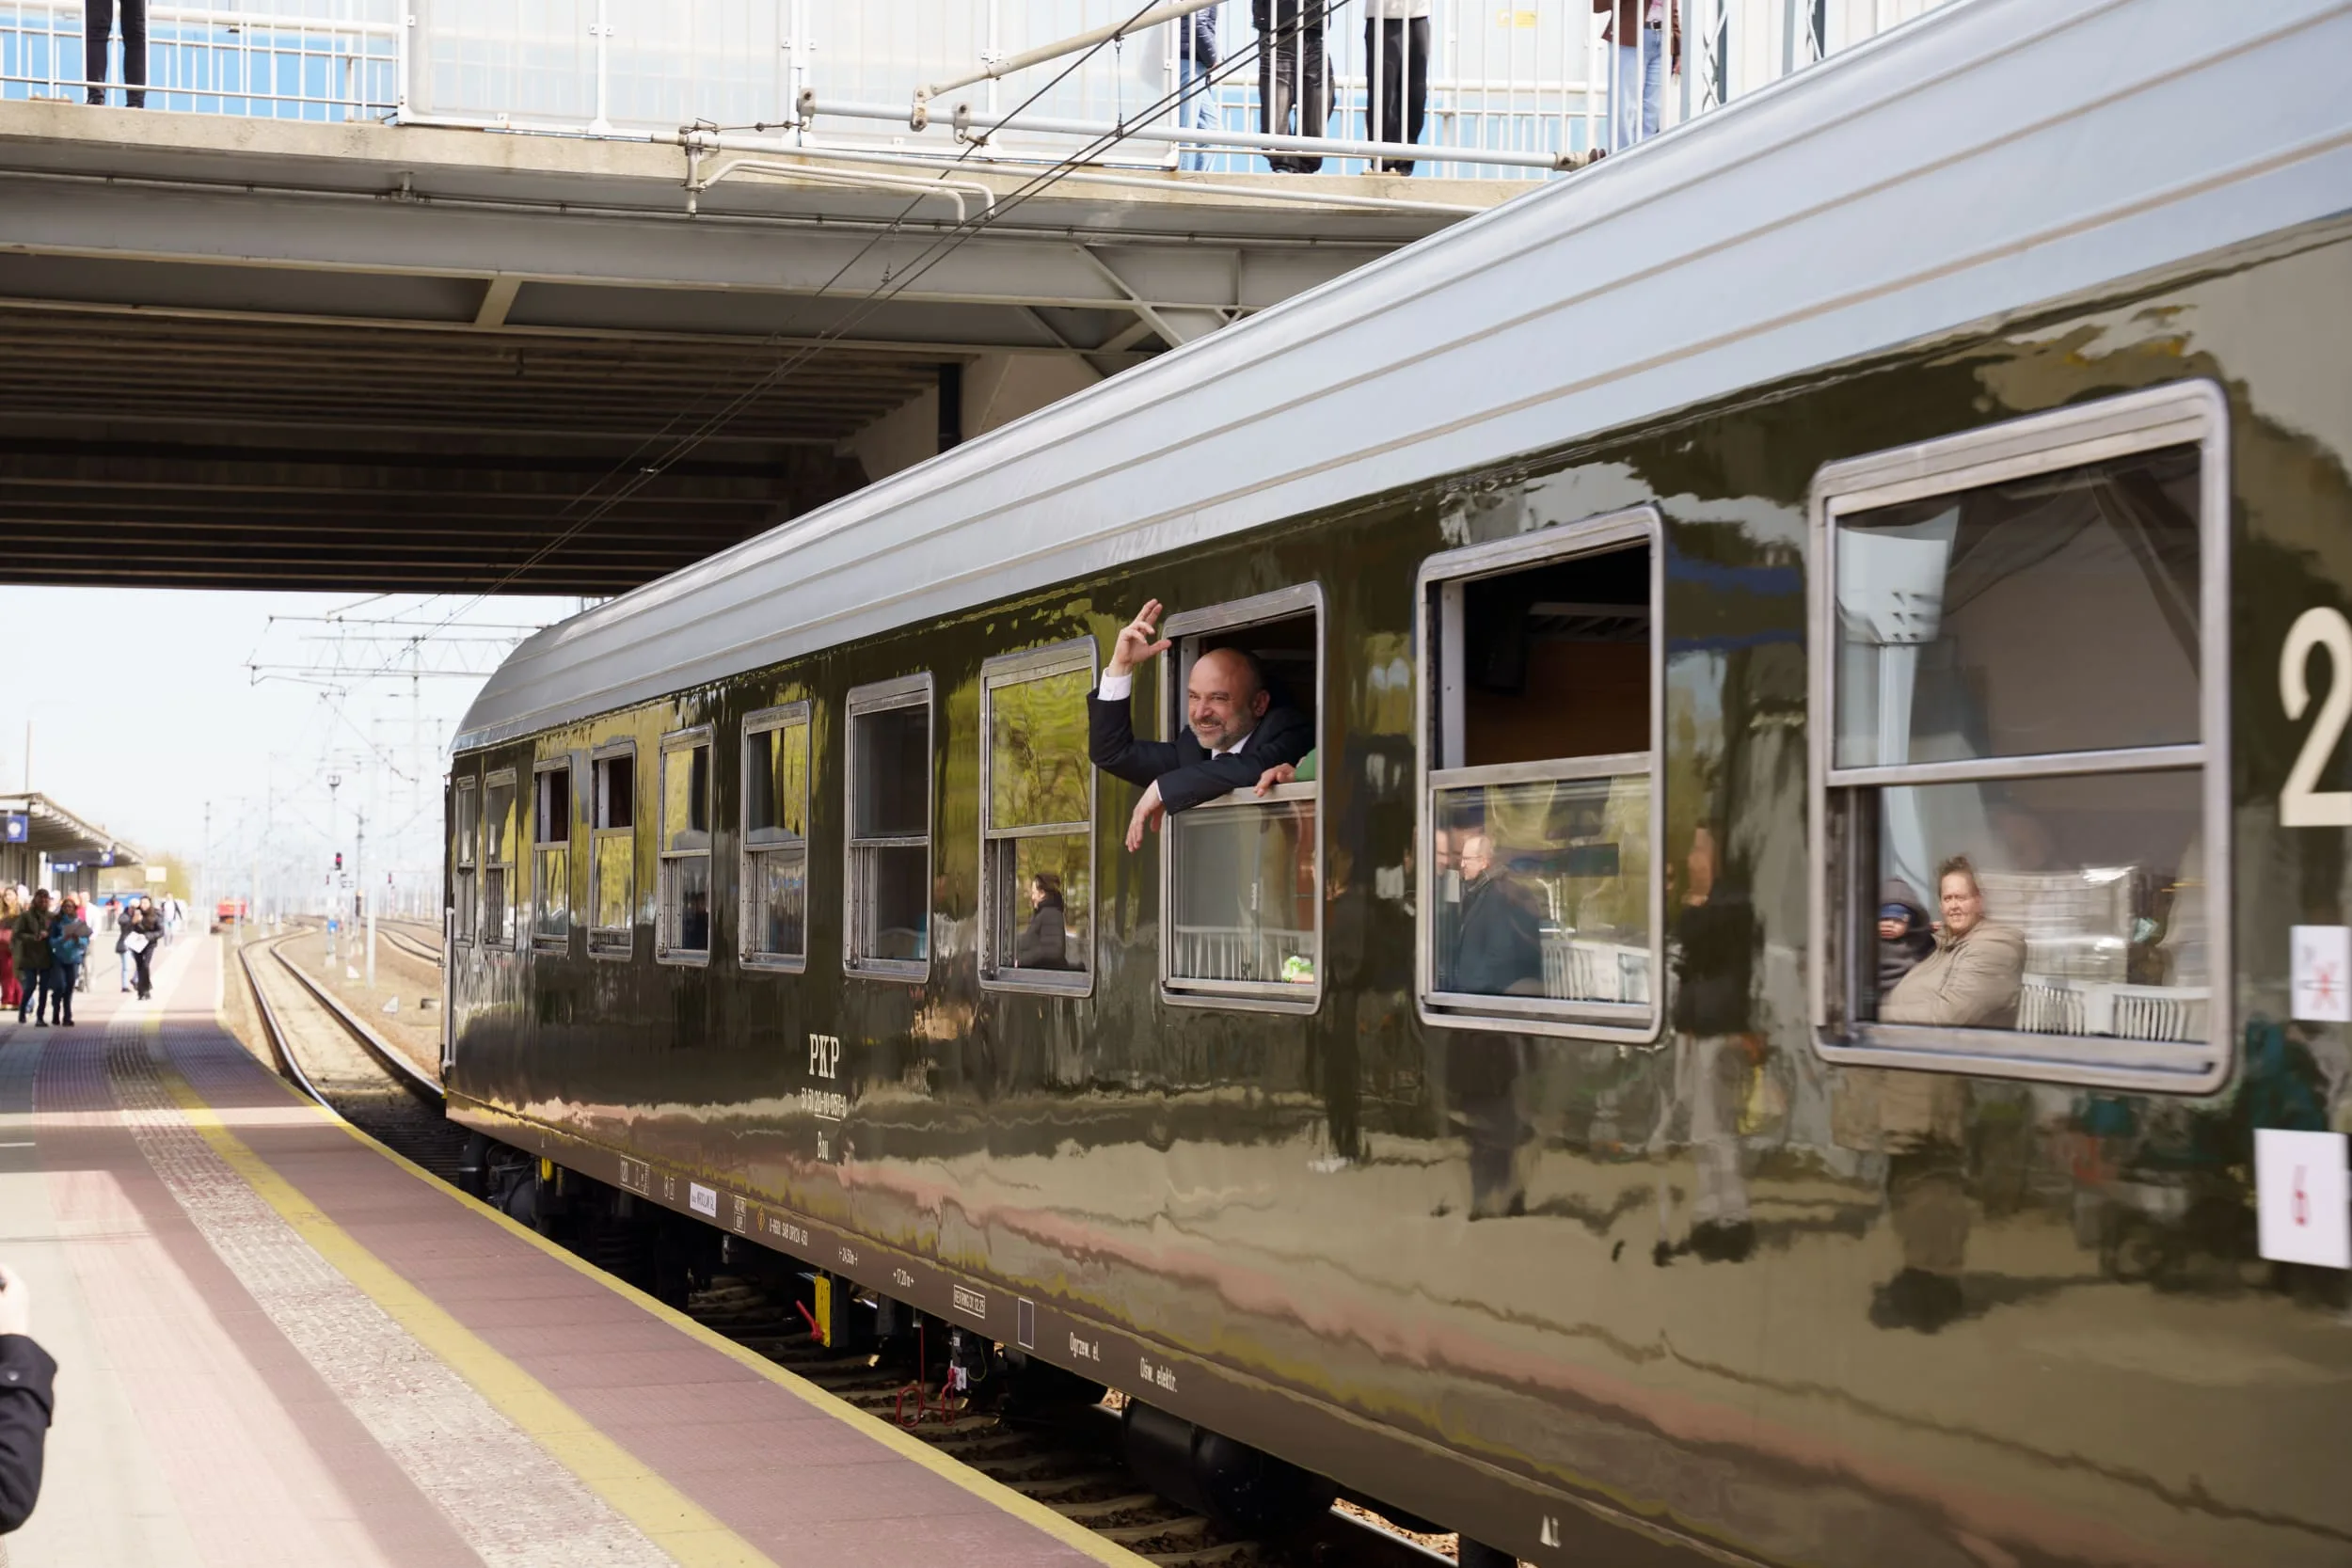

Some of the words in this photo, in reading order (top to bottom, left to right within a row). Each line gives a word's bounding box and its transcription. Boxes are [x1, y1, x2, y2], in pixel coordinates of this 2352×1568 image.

[2278, 606, 2352, 828] 2
[809, 1034, 839, 1080] PKP
[801, 1086, 807, 1110] 51
[808, 1088, 814, 1112] 51
[815, 1090, 830, 1116] 20-10
